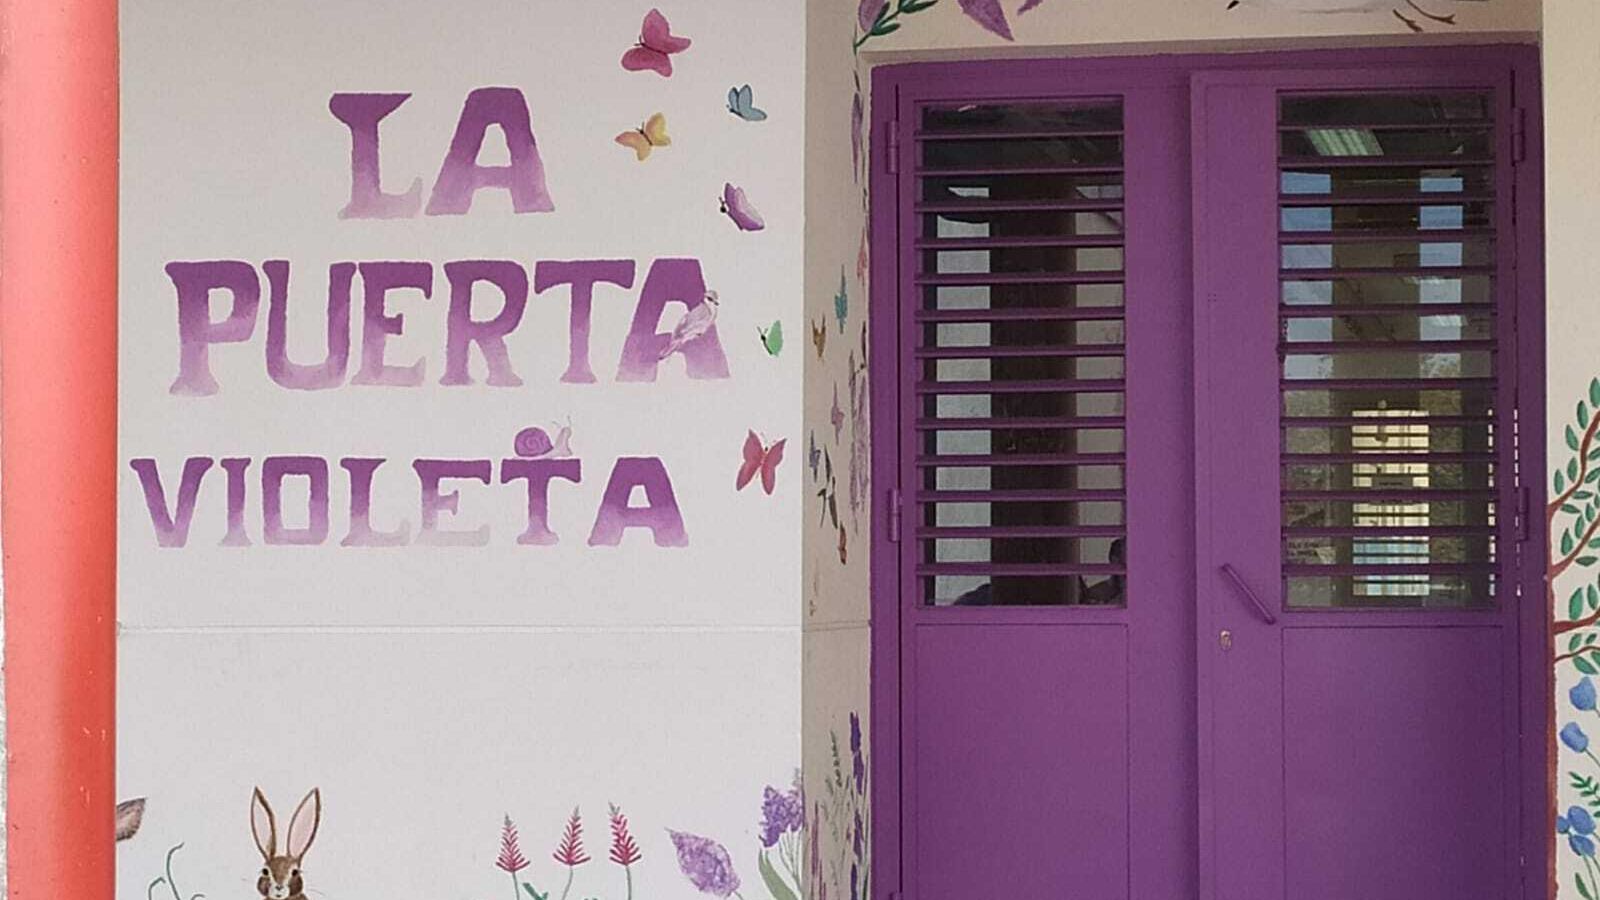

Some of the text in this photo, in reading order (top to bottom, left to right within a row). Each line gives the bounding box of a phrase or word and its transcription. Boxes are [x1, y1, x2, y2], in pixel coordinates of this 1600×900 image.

[329, 86, 553, 219] LA
[165, 257, 730, 394] PUERTA
[130, 456, 689, 548] VIOLETA
